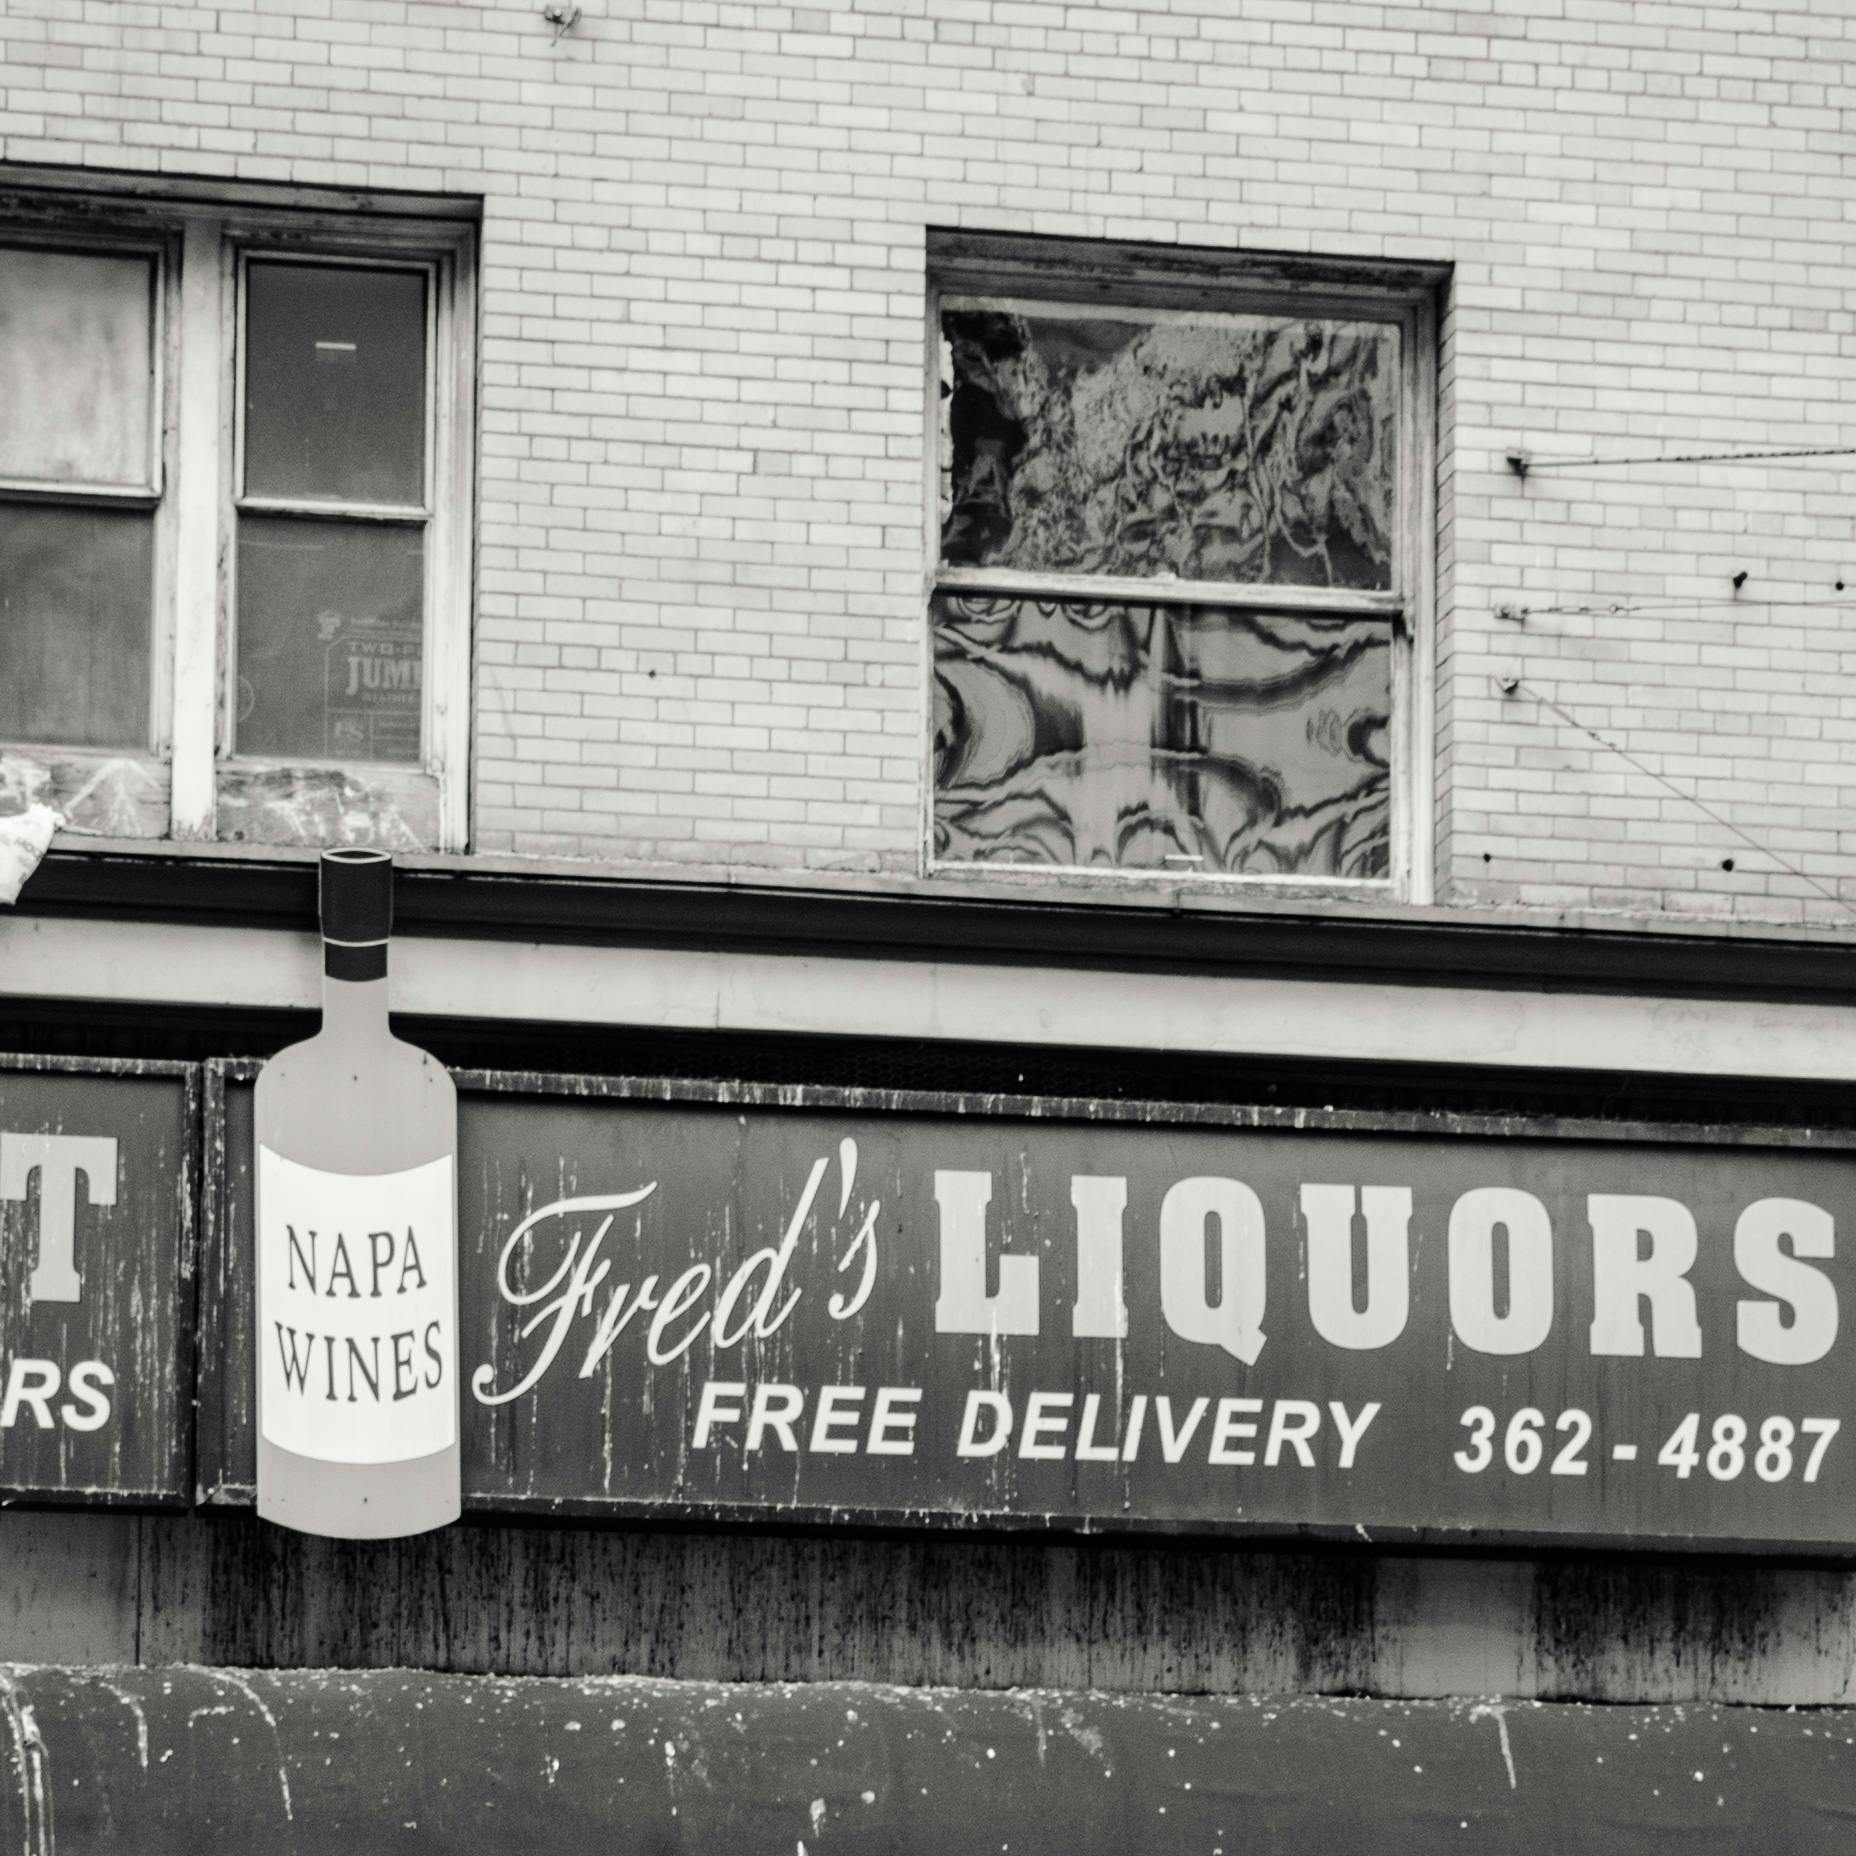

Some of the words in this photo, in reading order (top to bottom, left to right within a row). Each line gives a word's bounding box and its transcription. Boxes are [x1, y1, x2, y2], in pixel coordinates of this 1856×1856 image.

[285, 1225, 428, 1299] NAPA
[472, 1137, 881, 1405] Fred's
[934, 1169, 1839, 1367] LIQUORS
[274, 1320, 443, 1403] WINES
[691, 1381, 924, 1456] FREE
[955, 1389, 1382, 1468] DELIVERY
